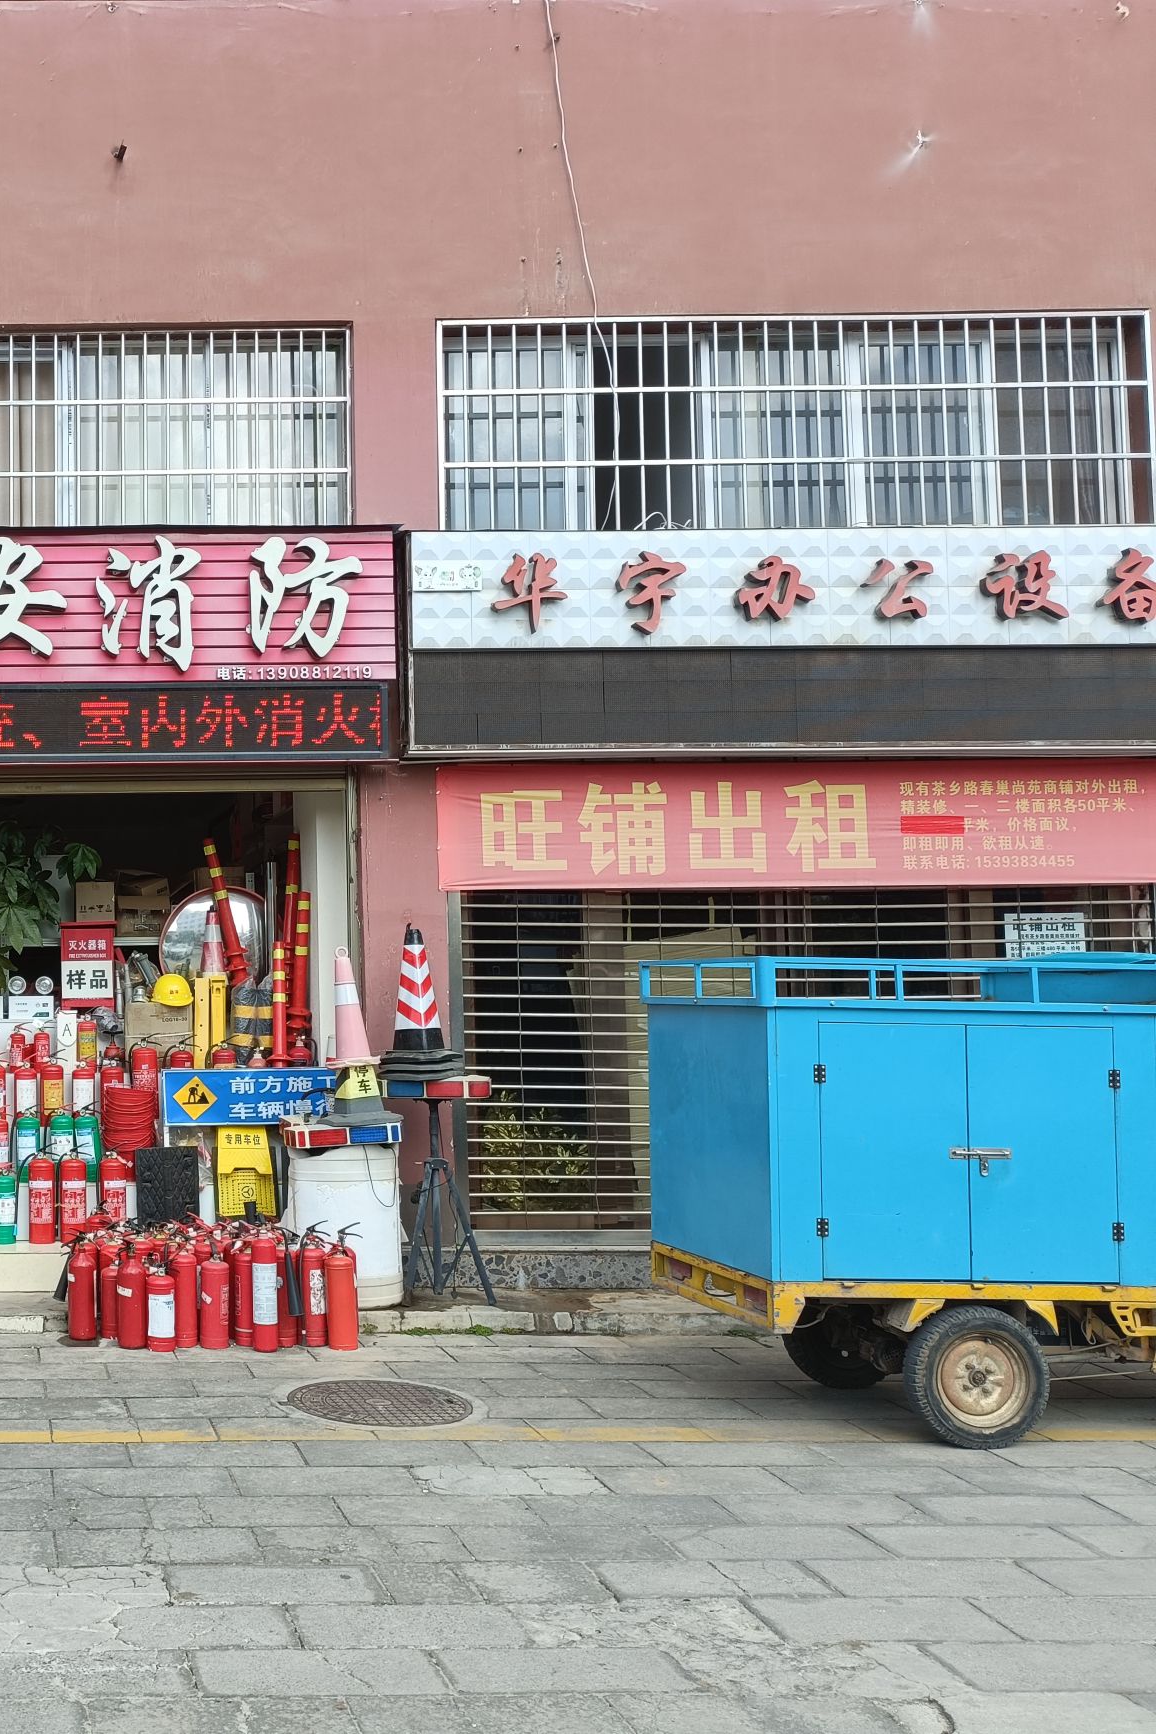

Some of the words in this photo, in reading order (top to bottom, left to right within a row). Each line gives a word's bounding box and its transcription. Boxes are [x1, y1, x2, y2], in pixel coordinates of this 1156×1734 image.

[491, 546, 1156, 634] 华宇办公设备
[480, 778, 877, 878] 旺铺出租
[69, 940, 106, 951] 灭火器箱
[66, 969, 108, 990] 样品
[225, 1134, 261, 1146] 专用车位
